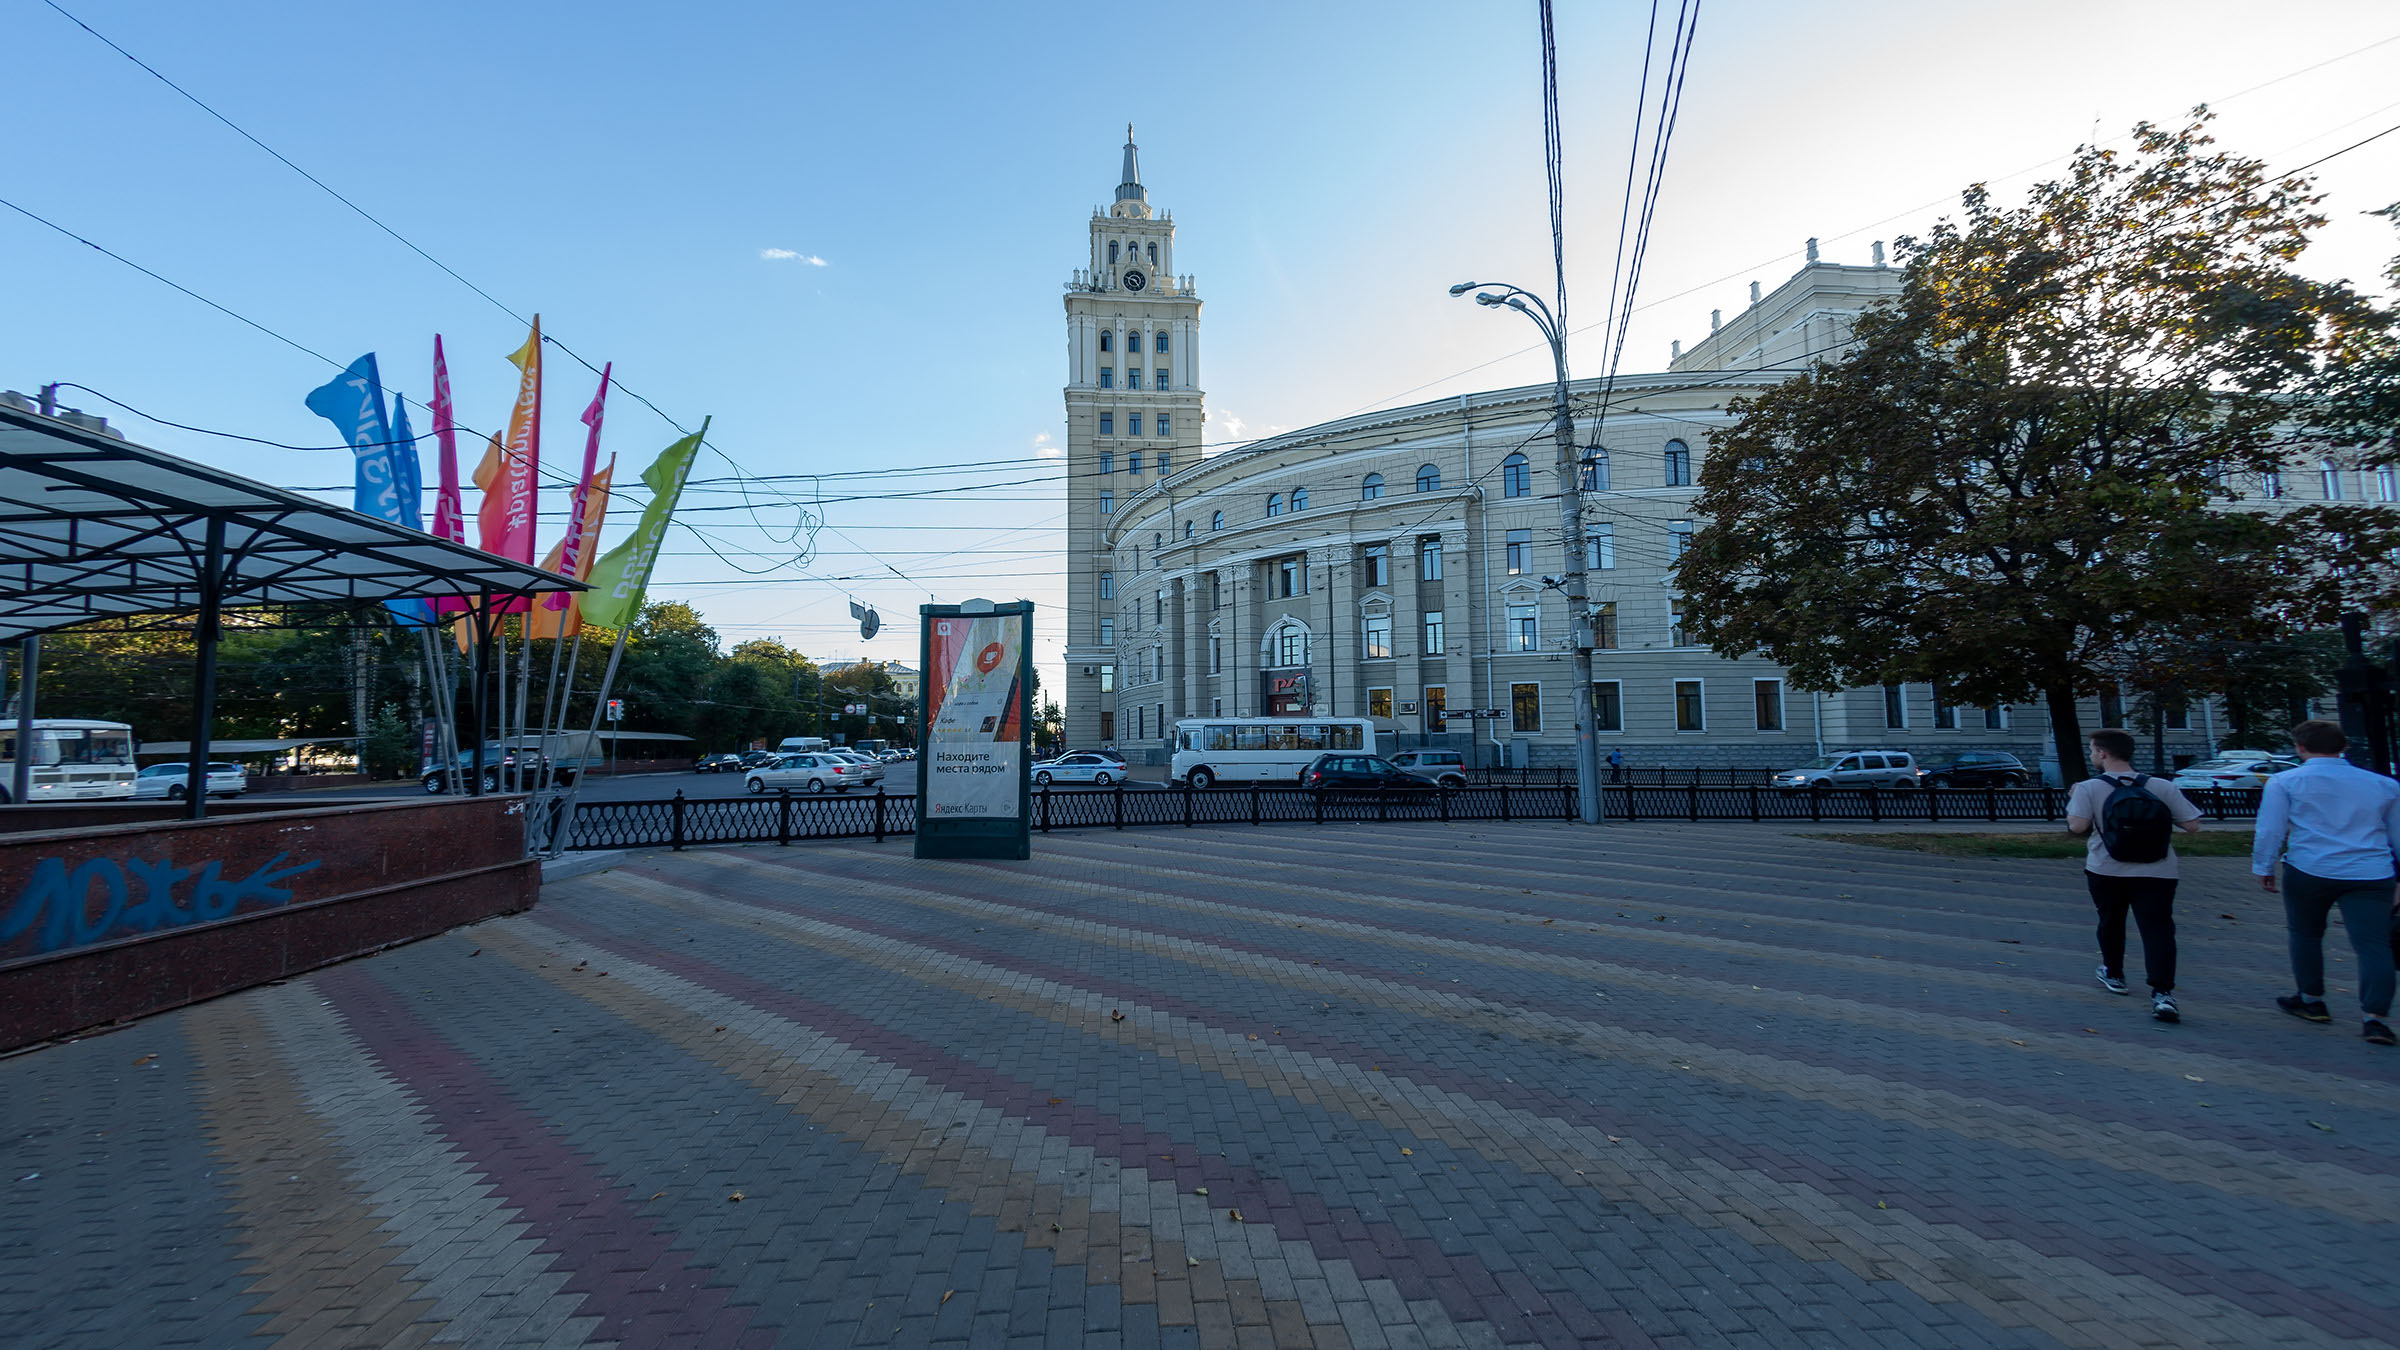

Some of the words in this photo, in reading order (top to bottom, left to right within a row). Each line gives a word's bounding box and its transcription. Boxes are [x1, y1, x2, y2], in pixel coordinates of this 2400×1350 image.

[936, 752, 990, 763] Находите
[936, 765, 970, 774] места
[971, 765, 1005, 775] рядом
[935, 803, 962, 814] Яндекс
[964, 803, 987, 814] Карты
